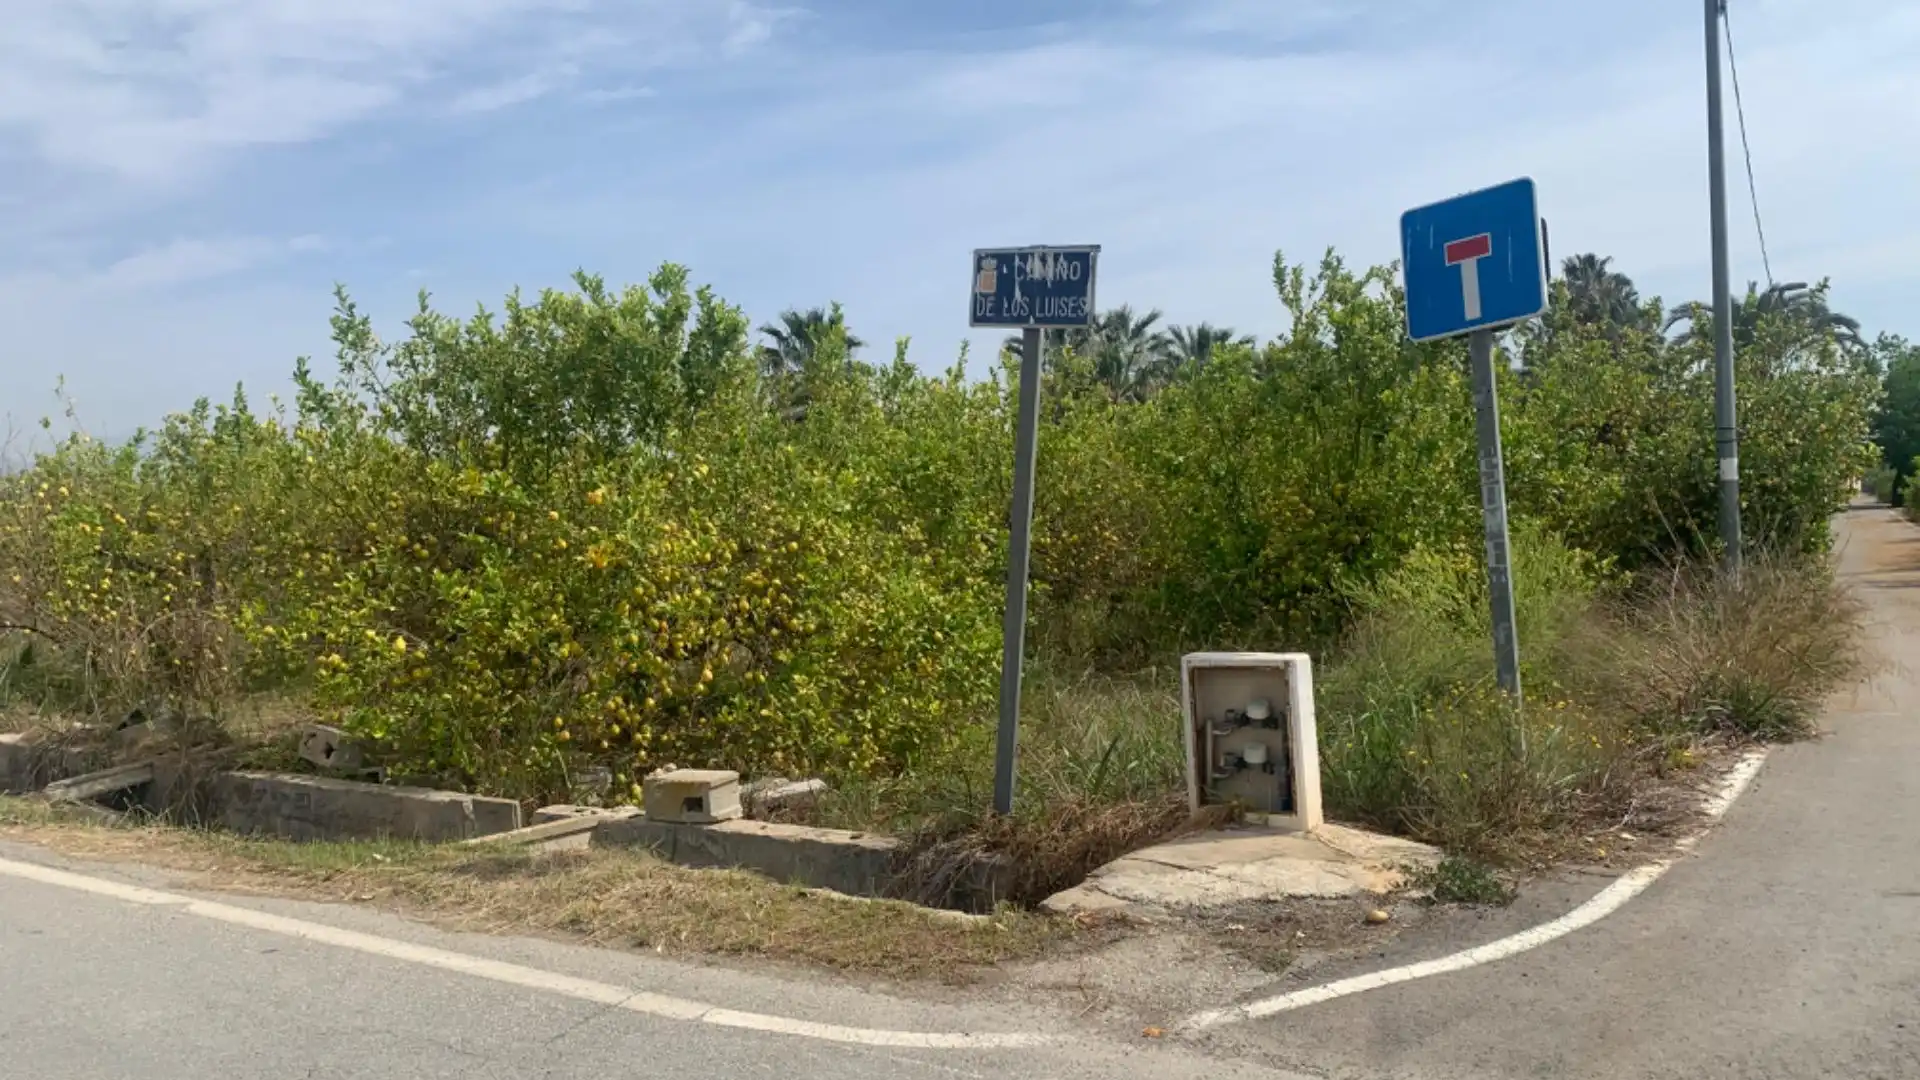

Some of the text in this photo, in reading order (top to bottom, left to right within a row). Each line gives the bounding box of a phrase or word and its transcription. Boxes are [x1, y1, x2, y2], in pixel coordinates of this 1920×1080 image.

[976, 296, 1088, 317] DE LOS LUISES
